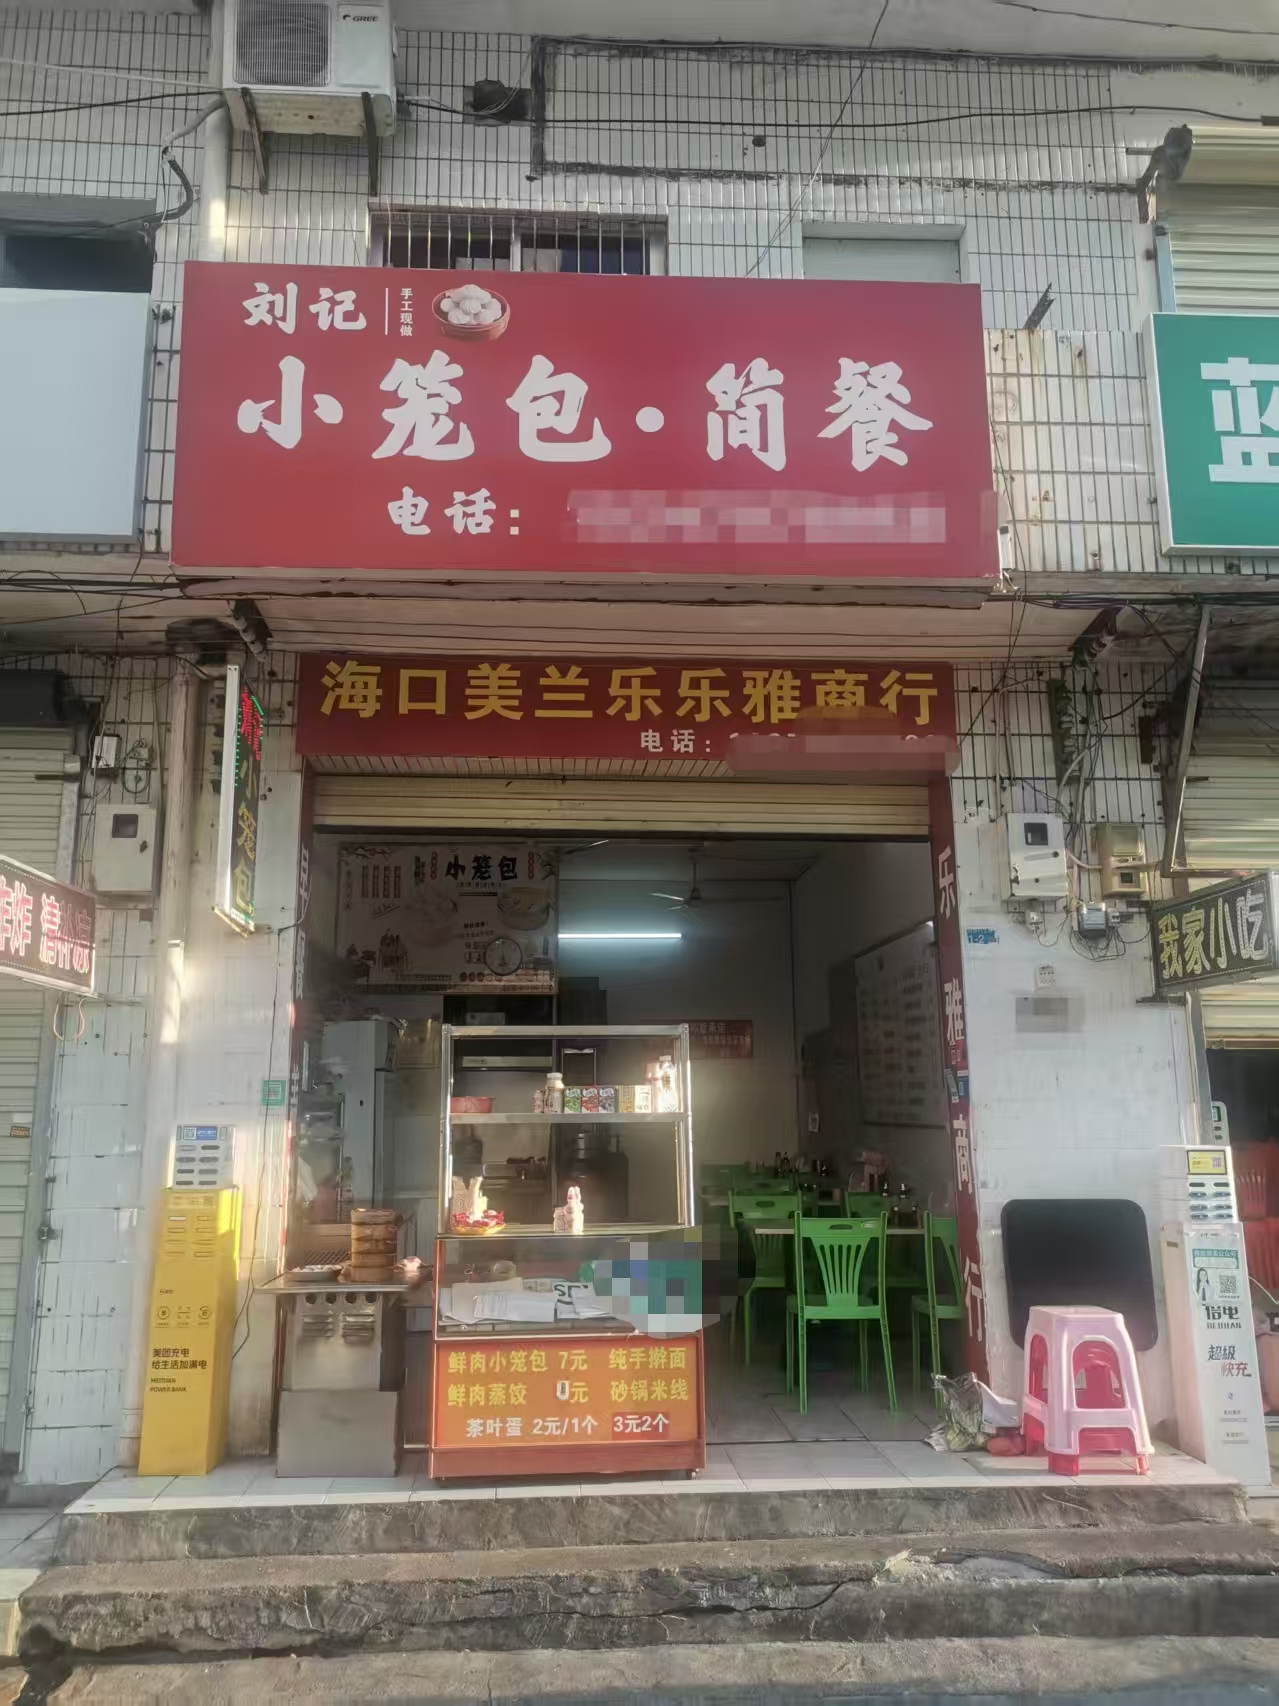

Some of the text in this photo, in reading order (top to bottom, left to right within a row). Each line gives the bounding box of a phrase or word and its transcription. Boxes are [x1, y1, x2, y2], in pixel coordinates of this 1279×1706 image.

[242, 281, 367, 334] 刘记
[400, 287, 413, 337] 手工现做
[320, 659, 938, 726] 海口美兰乐乐雅商行
[1158, 888, 1268, 979] 我家小吃
[152, 1347, 190, 1358] 美团充电
[447, 1350, 548, 1374] 鲜肉小笼包
[558, 1351, 588, 1371] 7元
[447, 1382, 528, 1408] 鲜肉蒸饺
[610, 1378, 689, 1402] 砂锅米线
[466, 1412, 669, 1438] 茶叶蛋 2元/1个 3元2个
